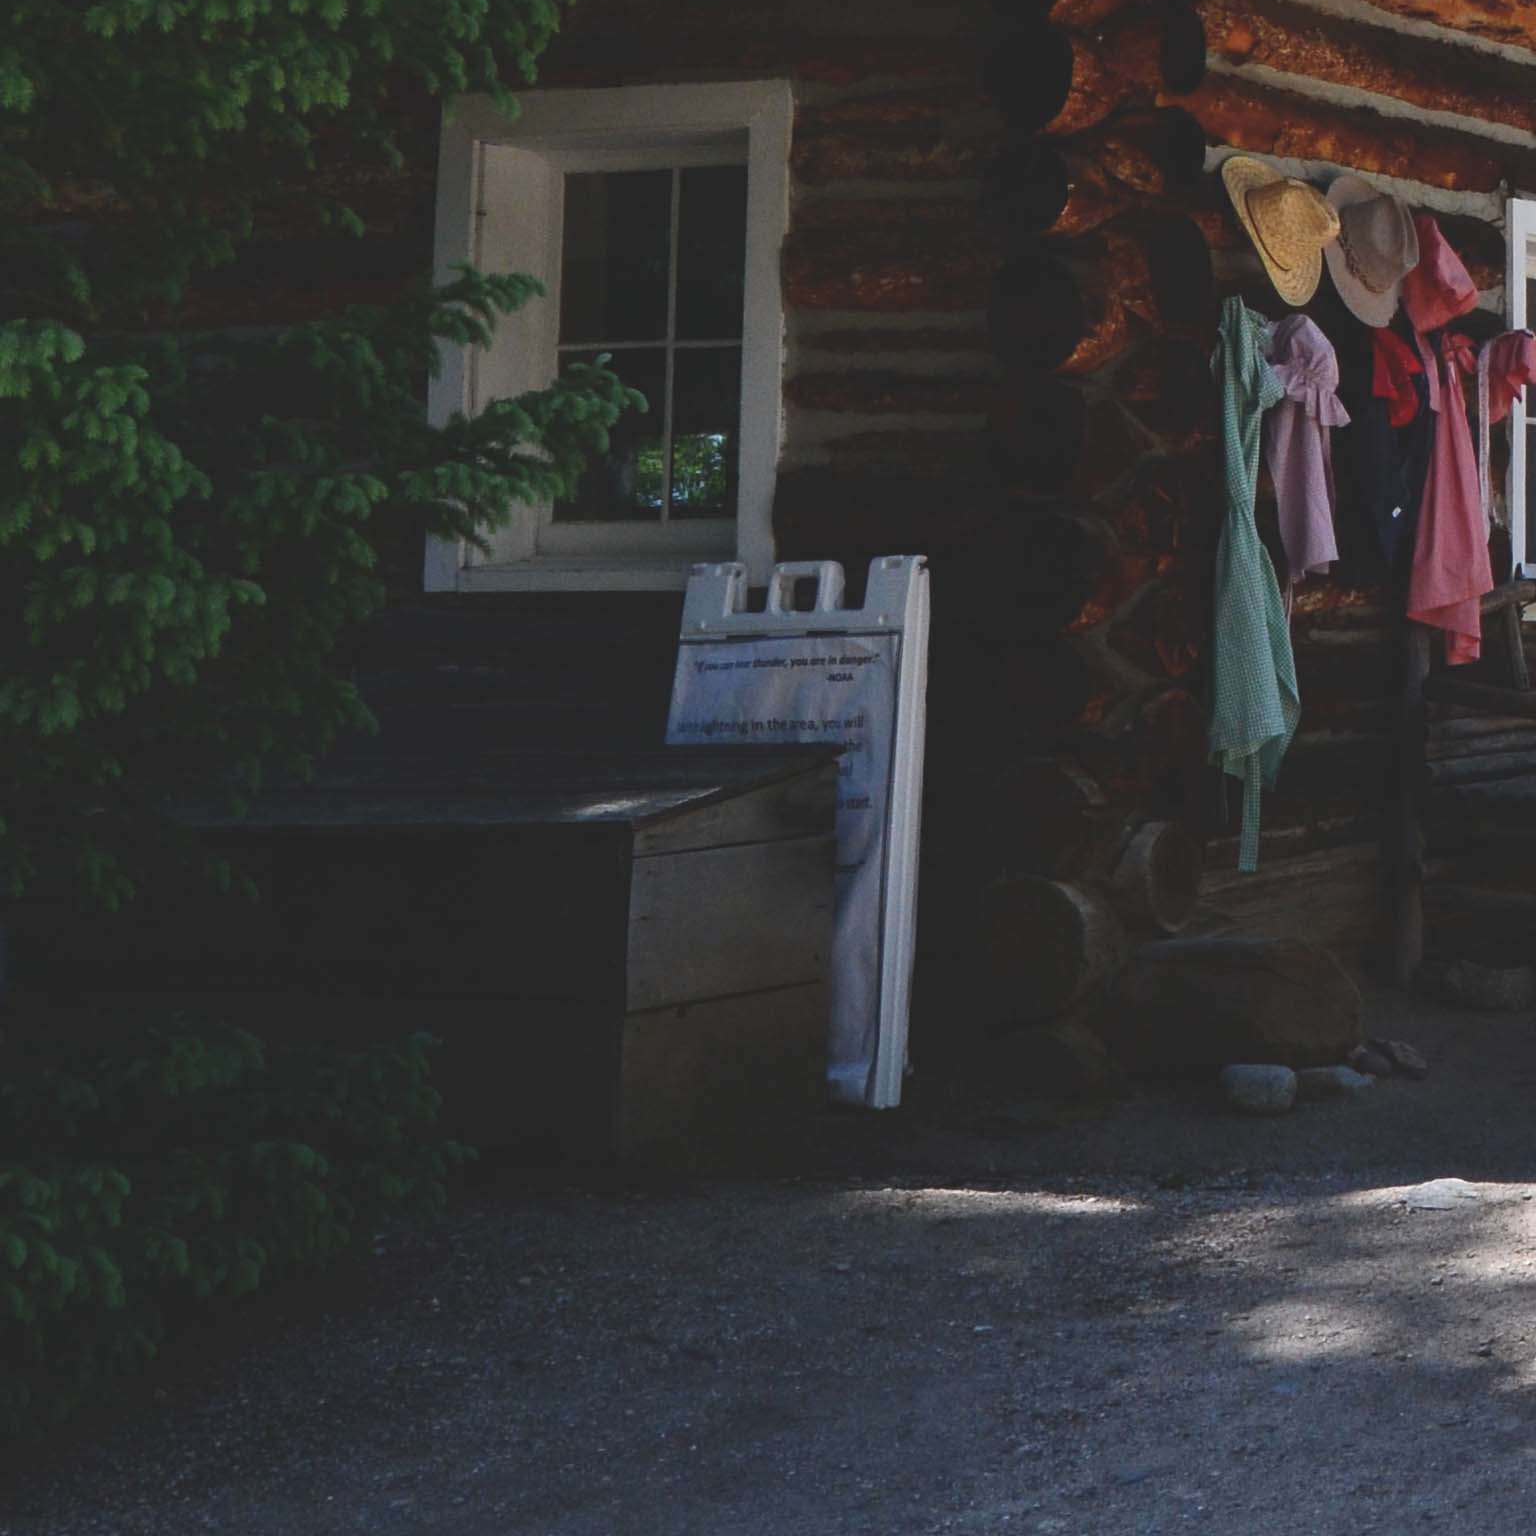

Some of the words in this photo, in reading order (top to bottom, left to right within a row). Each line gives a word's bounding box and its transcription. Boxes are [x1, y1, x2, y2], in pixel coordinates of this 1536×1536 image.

[790, 657, 808, 670] you
[809, 657, 825, 666] are
[827, 654, 837, 666] in
[751, 718, 764, 731] in
[766, 716, 785, 731] the
[788, 719, 819, 732] area,
[822, 719, 841, 733] you
[843, 713, 864, 728] will
